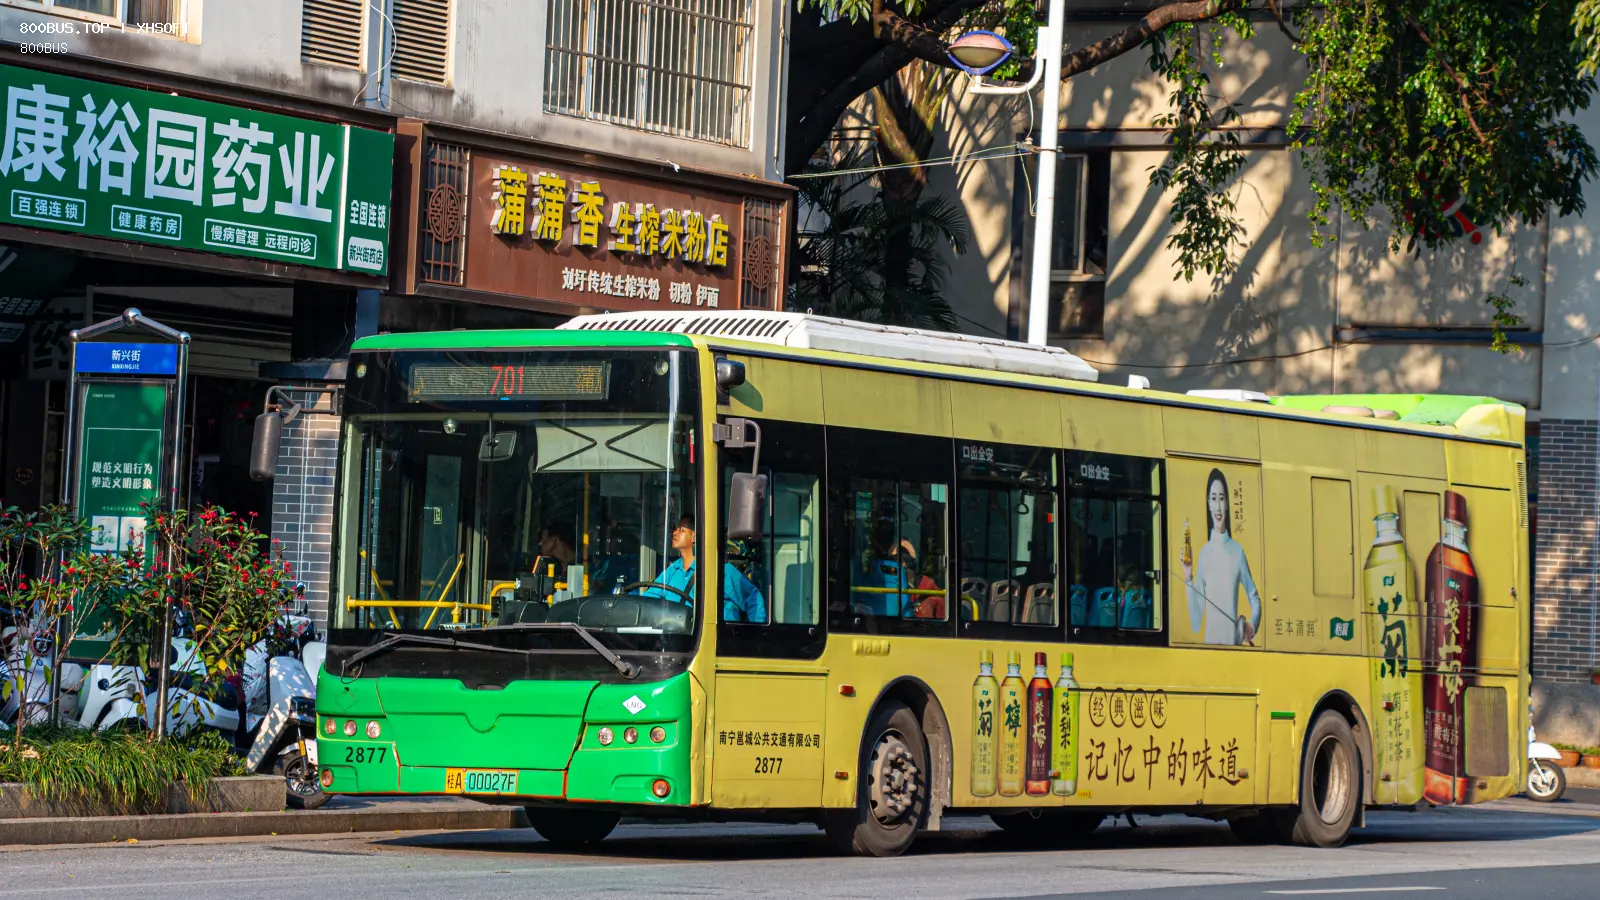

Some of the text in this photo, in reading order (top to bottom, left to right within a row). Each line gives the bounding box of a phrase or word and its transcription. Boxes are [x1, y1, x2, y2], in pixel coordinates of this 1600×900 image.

[0, 84, 335, 223] 康裕园药业
[18, 195, 79, 221] 百强连锁
[350, 199, 387, 229] 全国连锁
[491, 165, 729, 268] 蒲蒲香 生榨米粉店
[118, 209, 178, 235] 健康药房
[210, 224, 312, 254] 慢病管理 远程问诊
[349, 244, 383, 265] 新兴街药店
[562, 267, 720, 308] 刘圩传统生榨米粉 切粉 伊面
[111, 349, 141, 361] 新兴街
[489, 365, 525, 395] 701
[92, 461, 153, 475] 规范文明行为
[92, 476, 152, 490] 塑造文明形象
[1275, 617, 1315, 637] 至本清润
[625, 700, 643, 710] LNG
[1092, 697, 1165, 719] 经典滋味
[719, 730, 821, 749] 南宁邕城公共交通有限公司
[345, 747, 387, 764] 2877
[754, 757, 783, 774] 2877
[1085, 735, 1243, 790] 记忆中的味道
